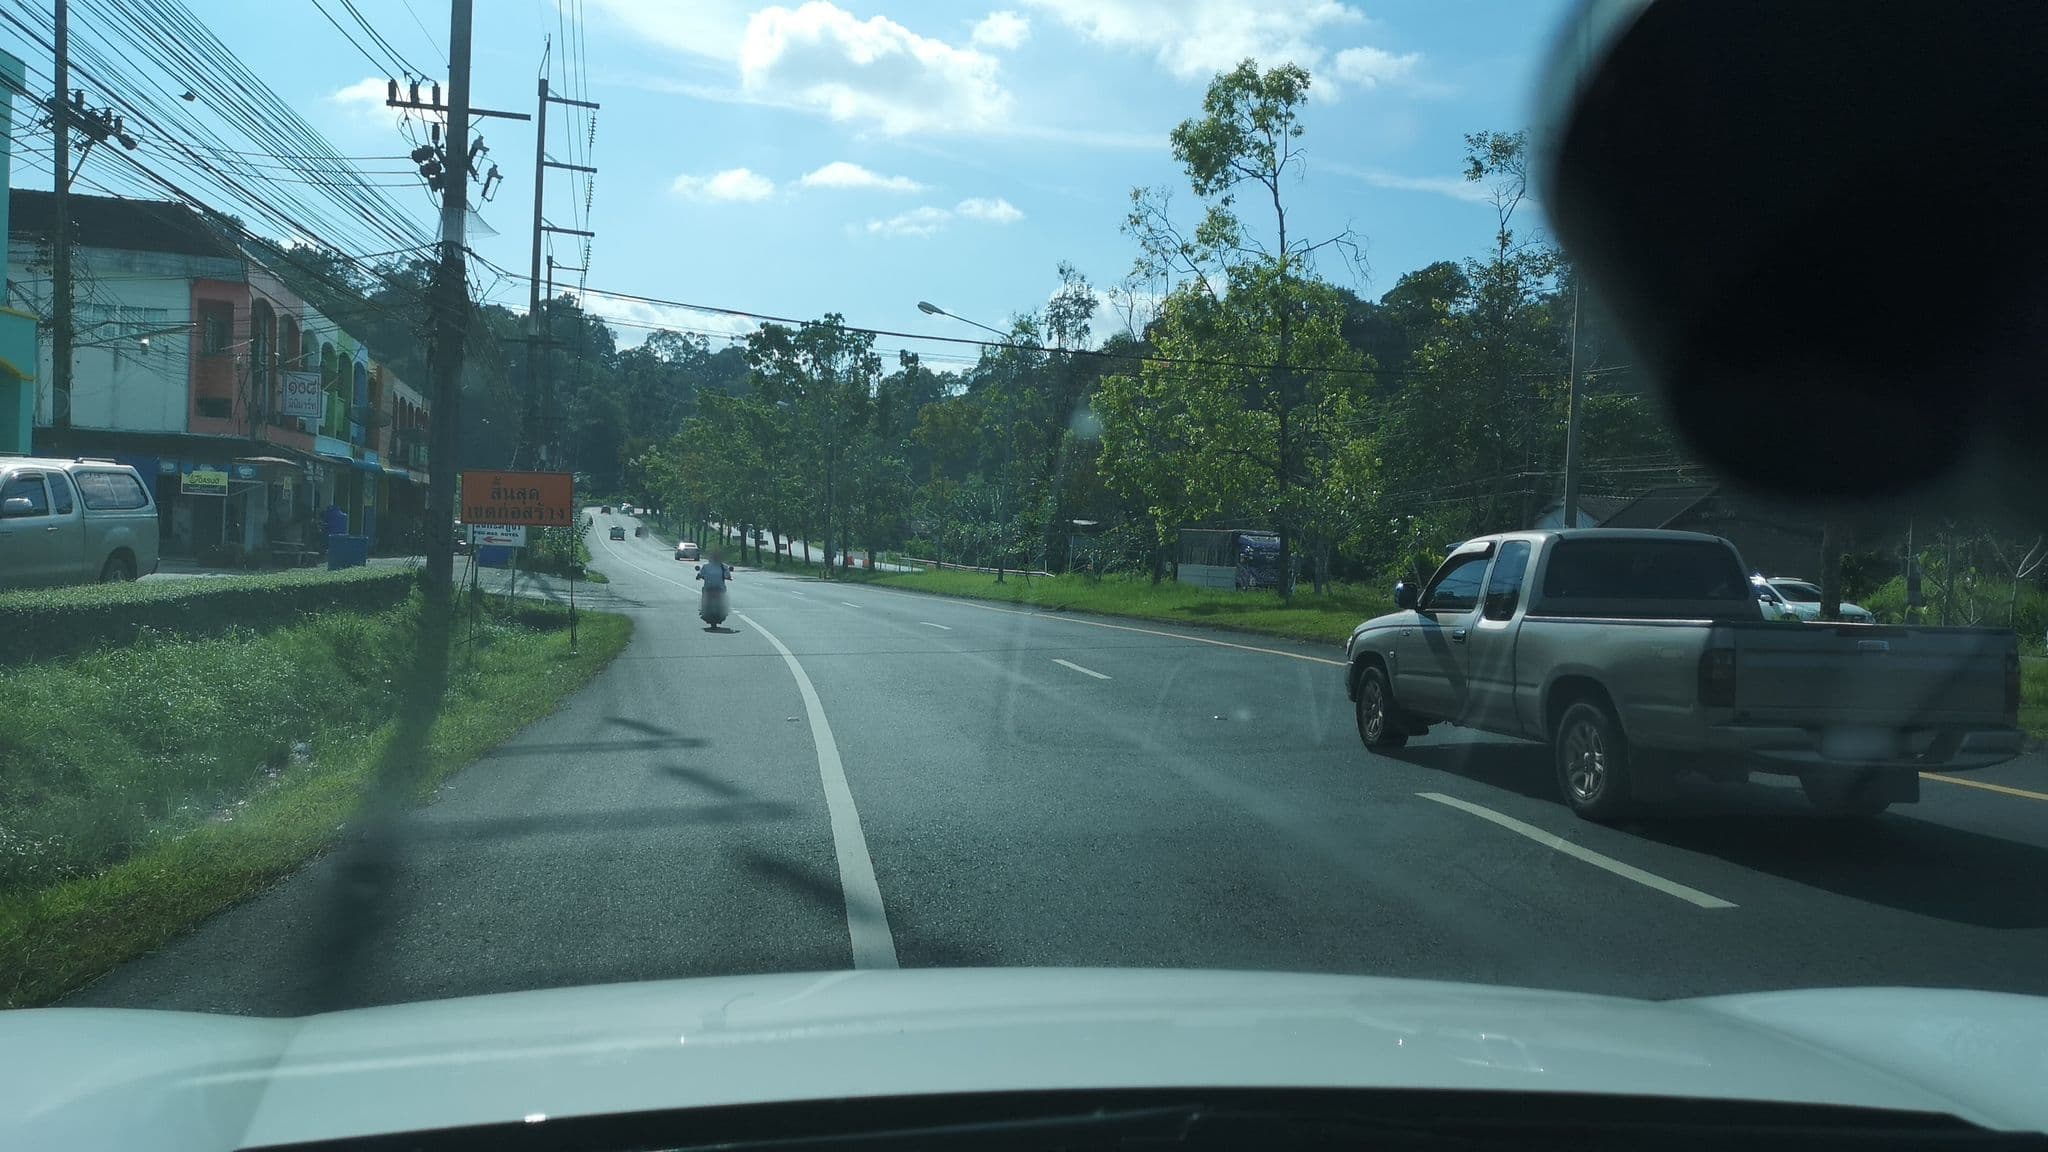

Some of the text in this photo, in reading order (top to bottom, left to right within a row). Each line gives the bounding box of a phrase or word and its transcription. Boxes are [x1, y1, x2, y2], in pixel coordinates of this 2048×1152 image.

[490, 475, 541, 504] สิ้นสุด
[467, 501, 566, 521] เขตก่อสร้าง
